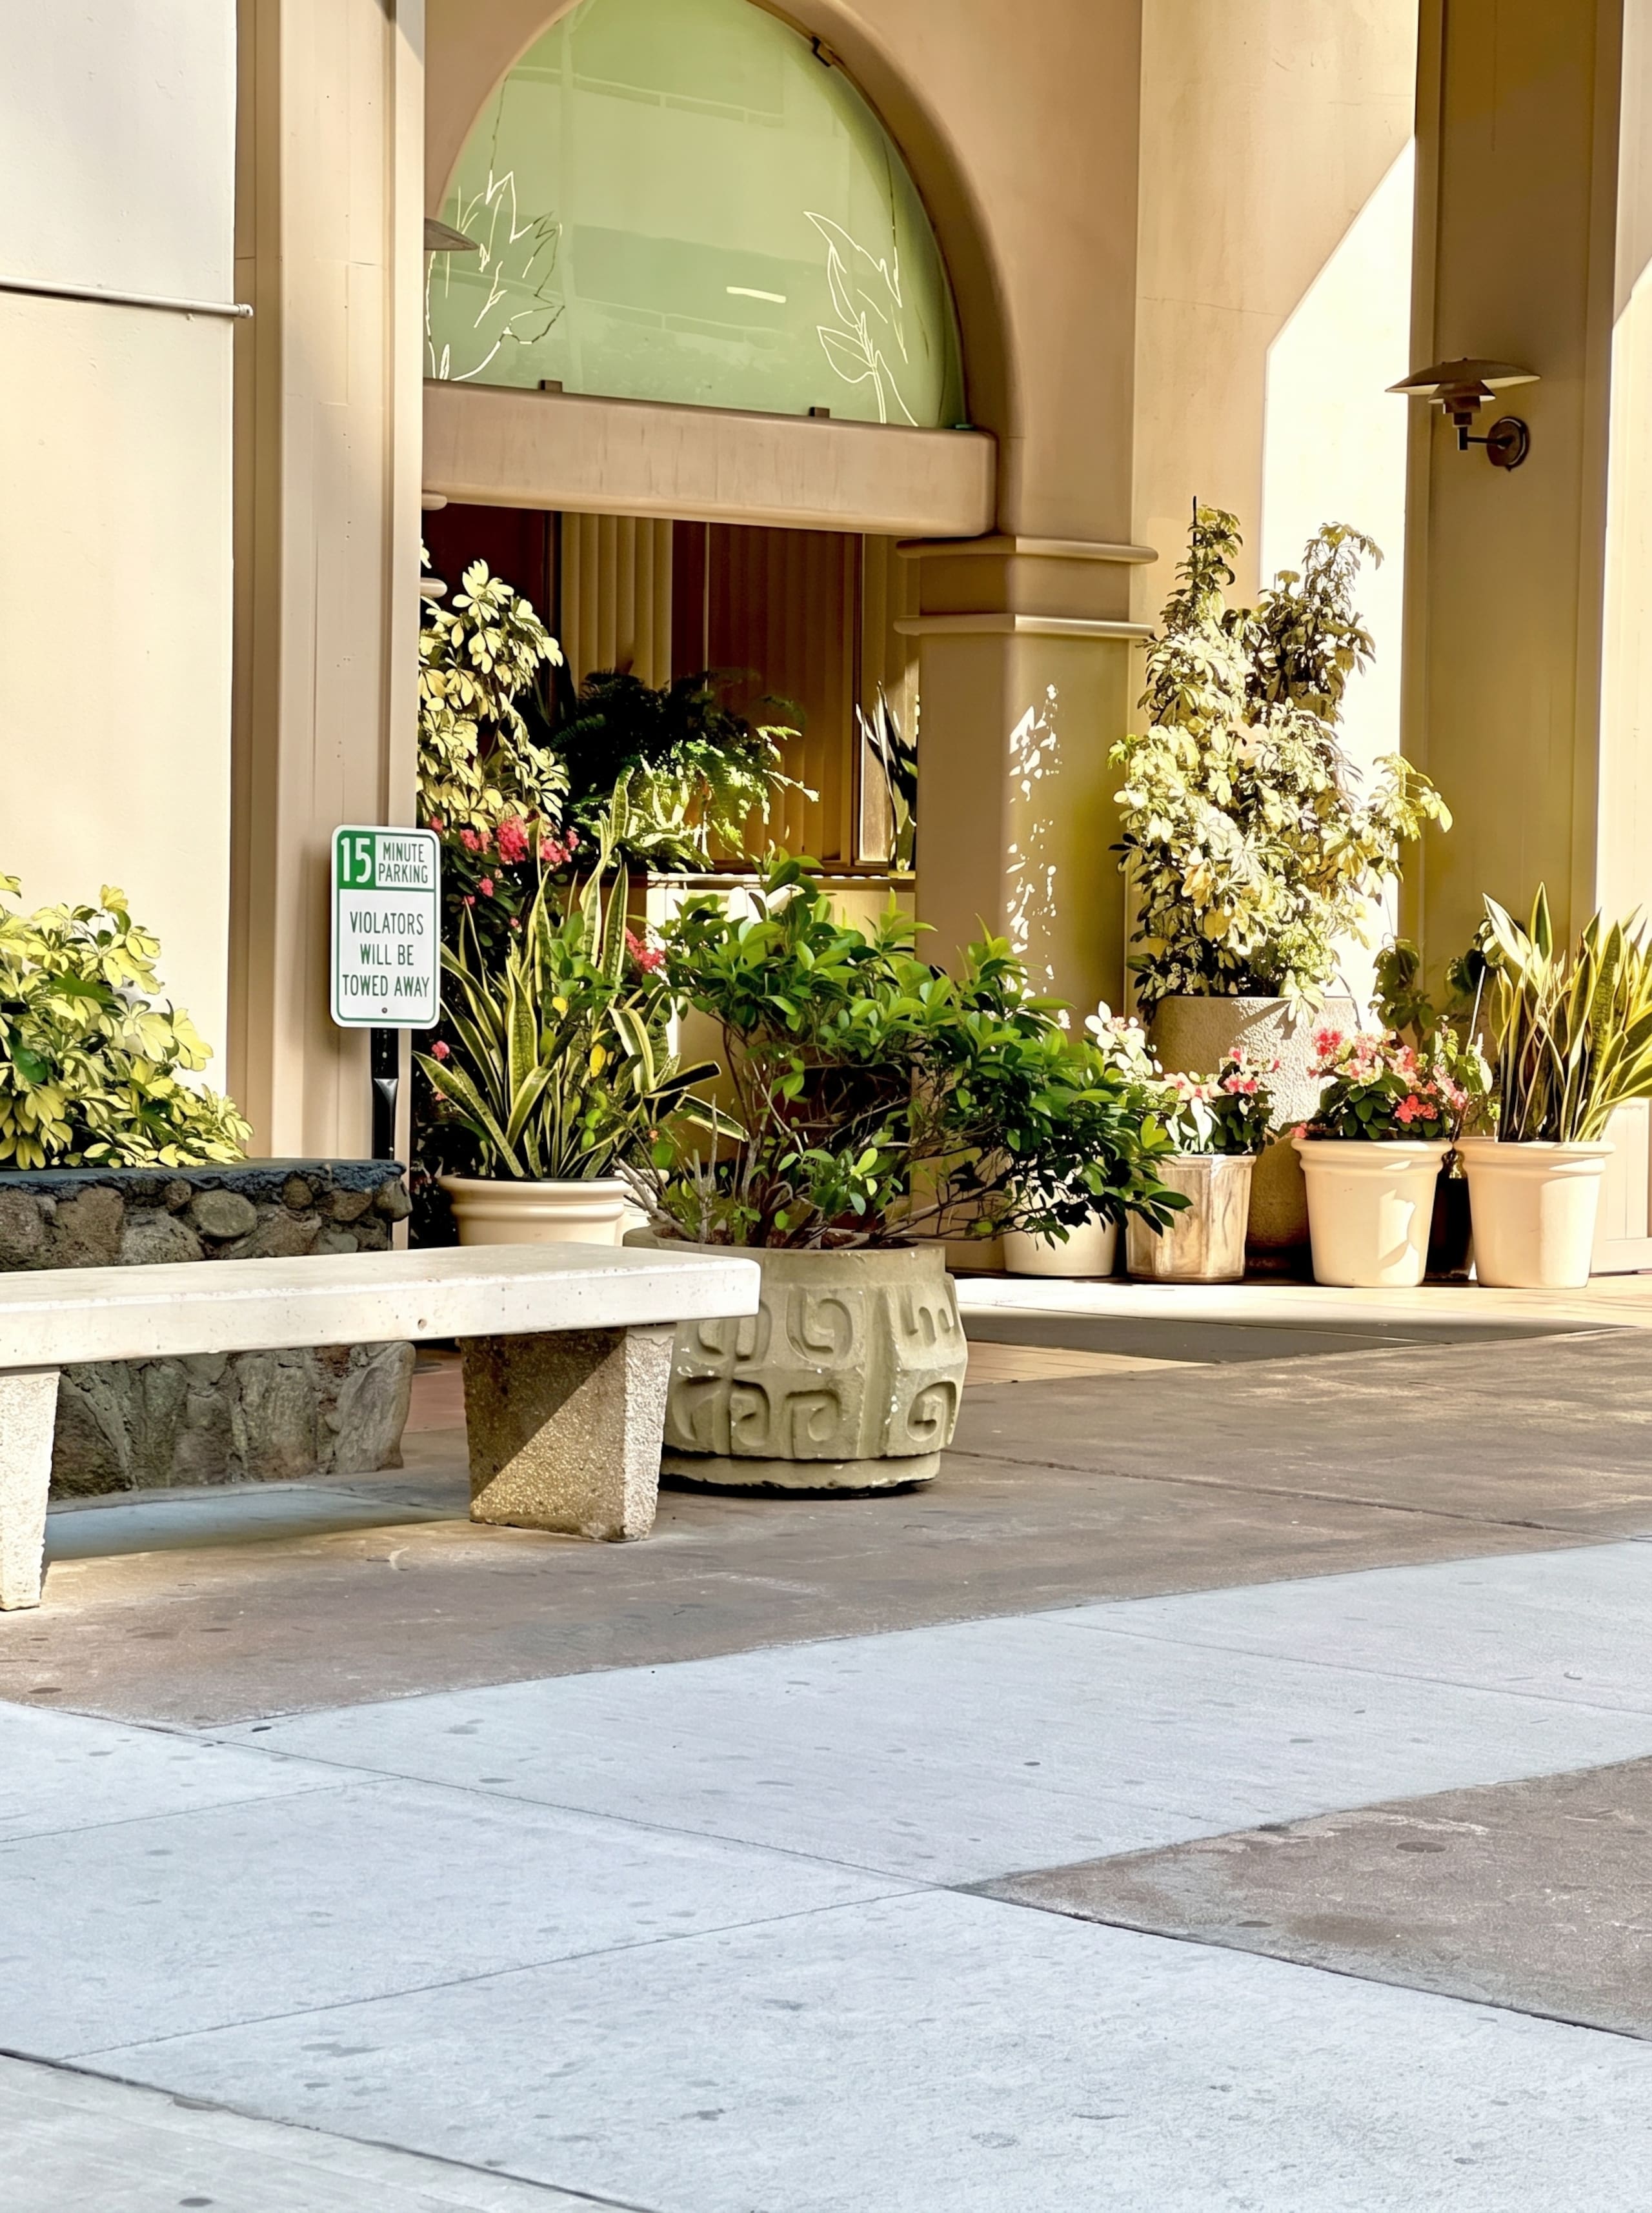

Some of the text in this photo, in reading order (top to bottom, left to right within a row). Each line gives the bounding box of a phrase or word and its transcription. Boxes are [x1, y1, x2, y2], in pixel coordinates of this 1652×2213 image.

[341, 837, 372, 883] 15
[383, 842, 425, 862] MINUTE
[378, 864, 428, 884] PARKING
[350, 911, 424, 935] VIOLATORS
[360, 944, 414, 965] WILL BE
[342, 975, 430, 997] TOWED AWAY
